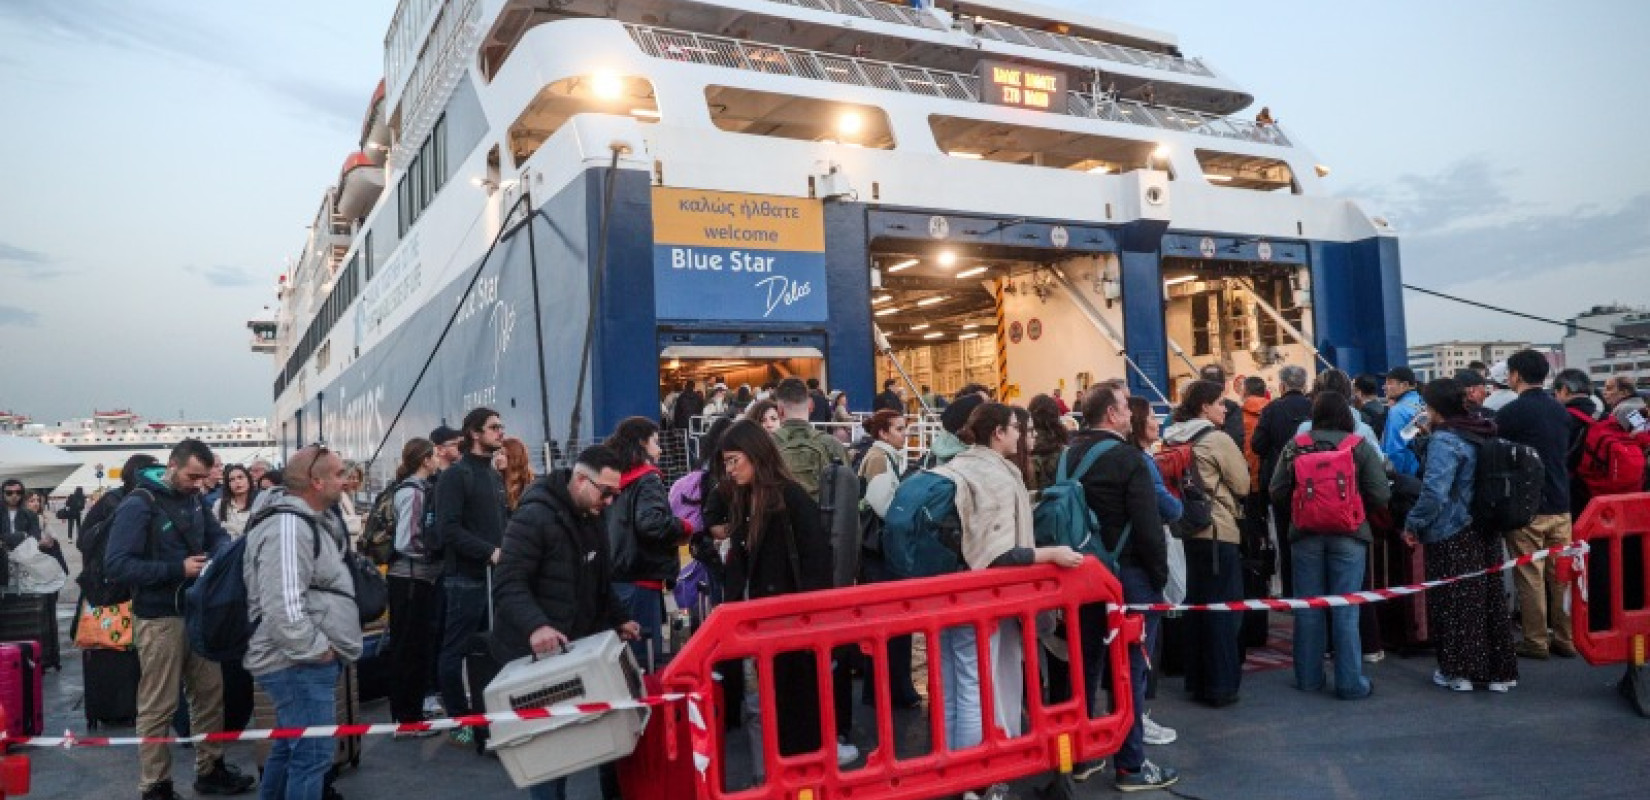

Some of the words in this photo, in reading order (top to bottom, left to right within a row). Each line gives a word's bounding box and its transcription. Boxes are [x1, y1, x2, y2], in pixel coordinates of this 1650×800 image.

[679, 196, 736, 218] καλώς
[704, 225, 779, 243] welcome
[671, 248, 723, 271] Blue
[729, 250, 776, 273] Star
[755, 275, 812, 318] Delos
